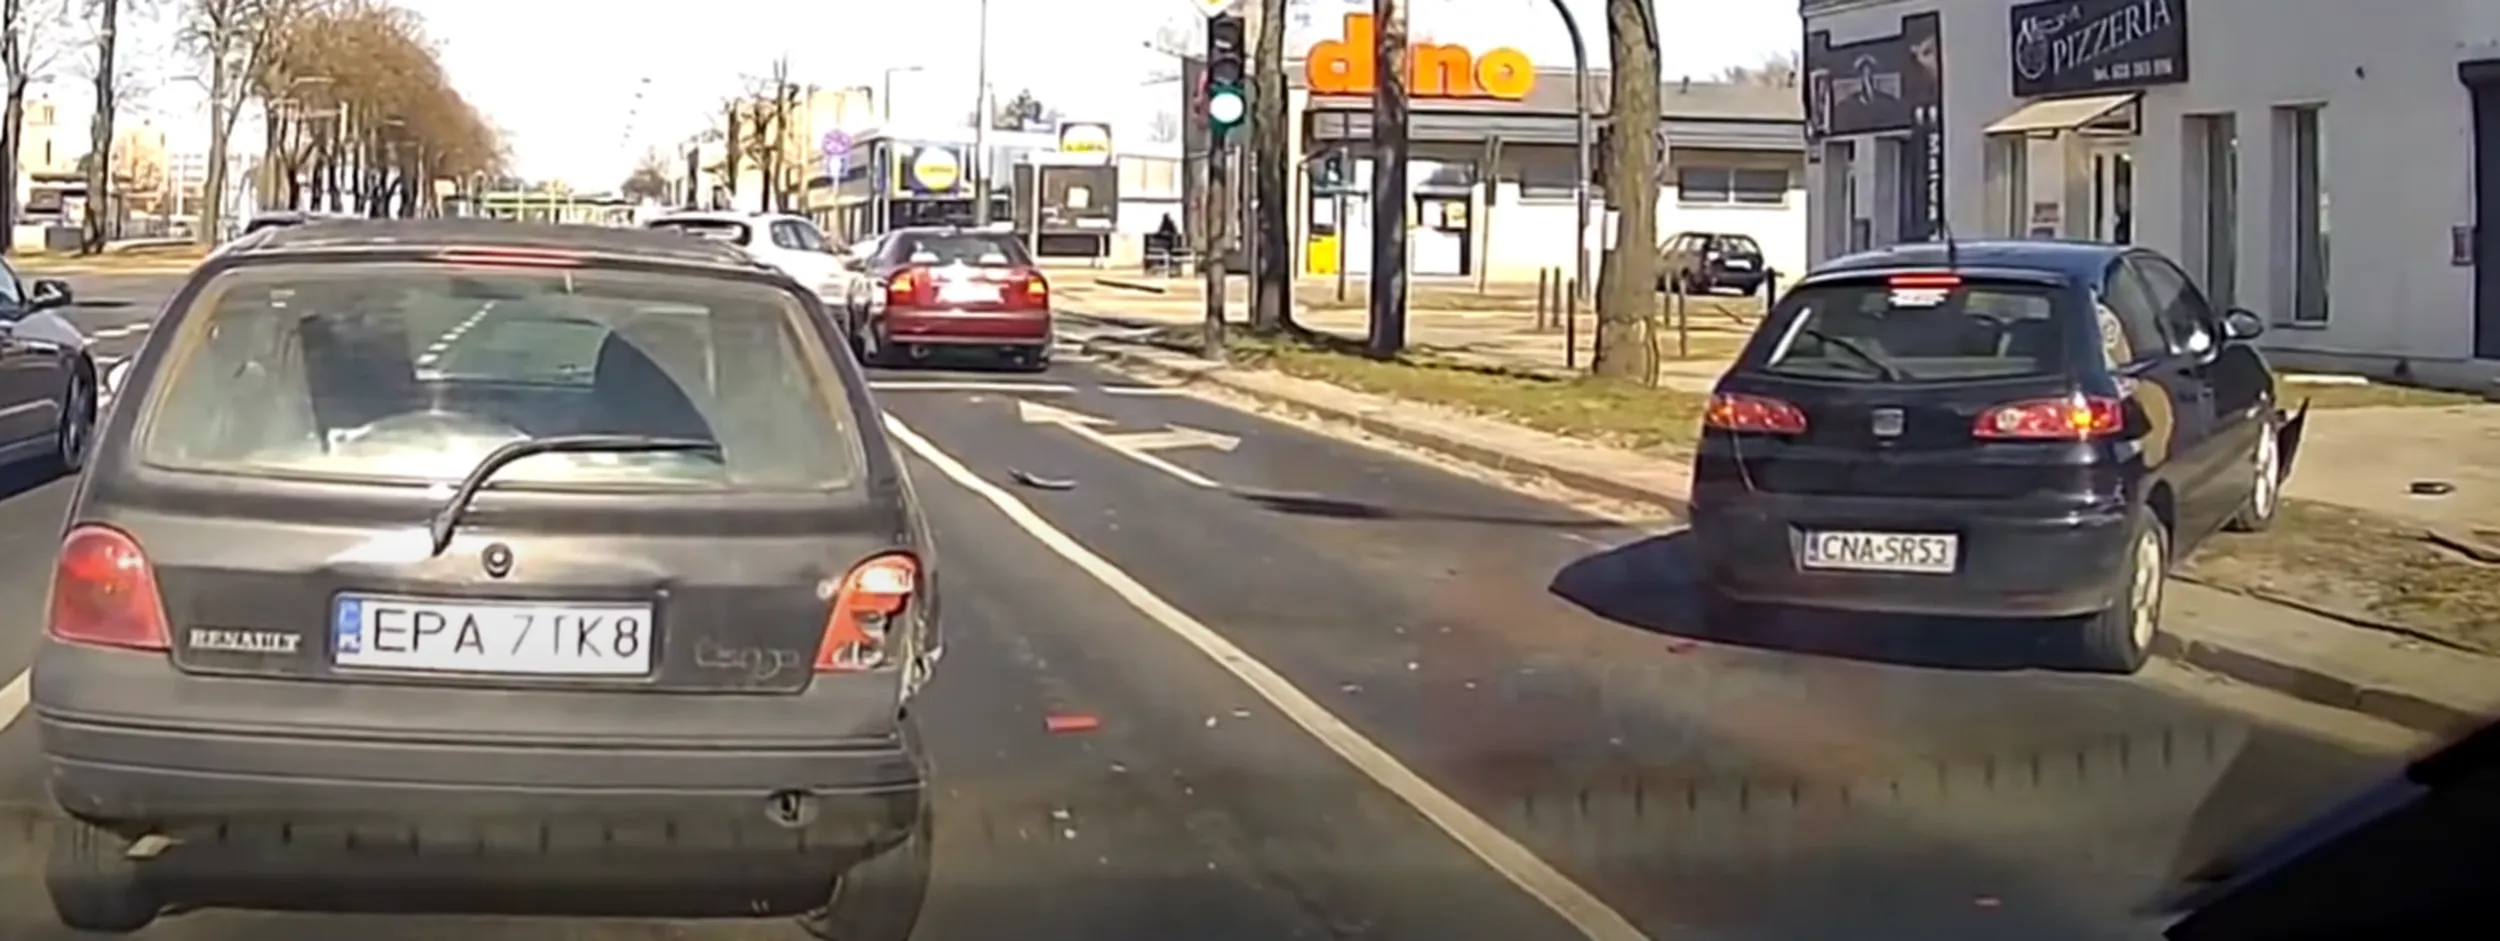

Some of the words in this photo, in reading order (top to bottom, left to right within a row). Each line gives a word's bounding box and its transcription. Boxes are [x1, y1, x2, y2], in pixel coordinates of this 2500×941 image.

[1306, 13, 1534, 99] dno
[2053, 0, 2171, 75] PIZZERIA
[189, 629, 301, 652] RENAULT
[374, 608, 485, 655] EPA
